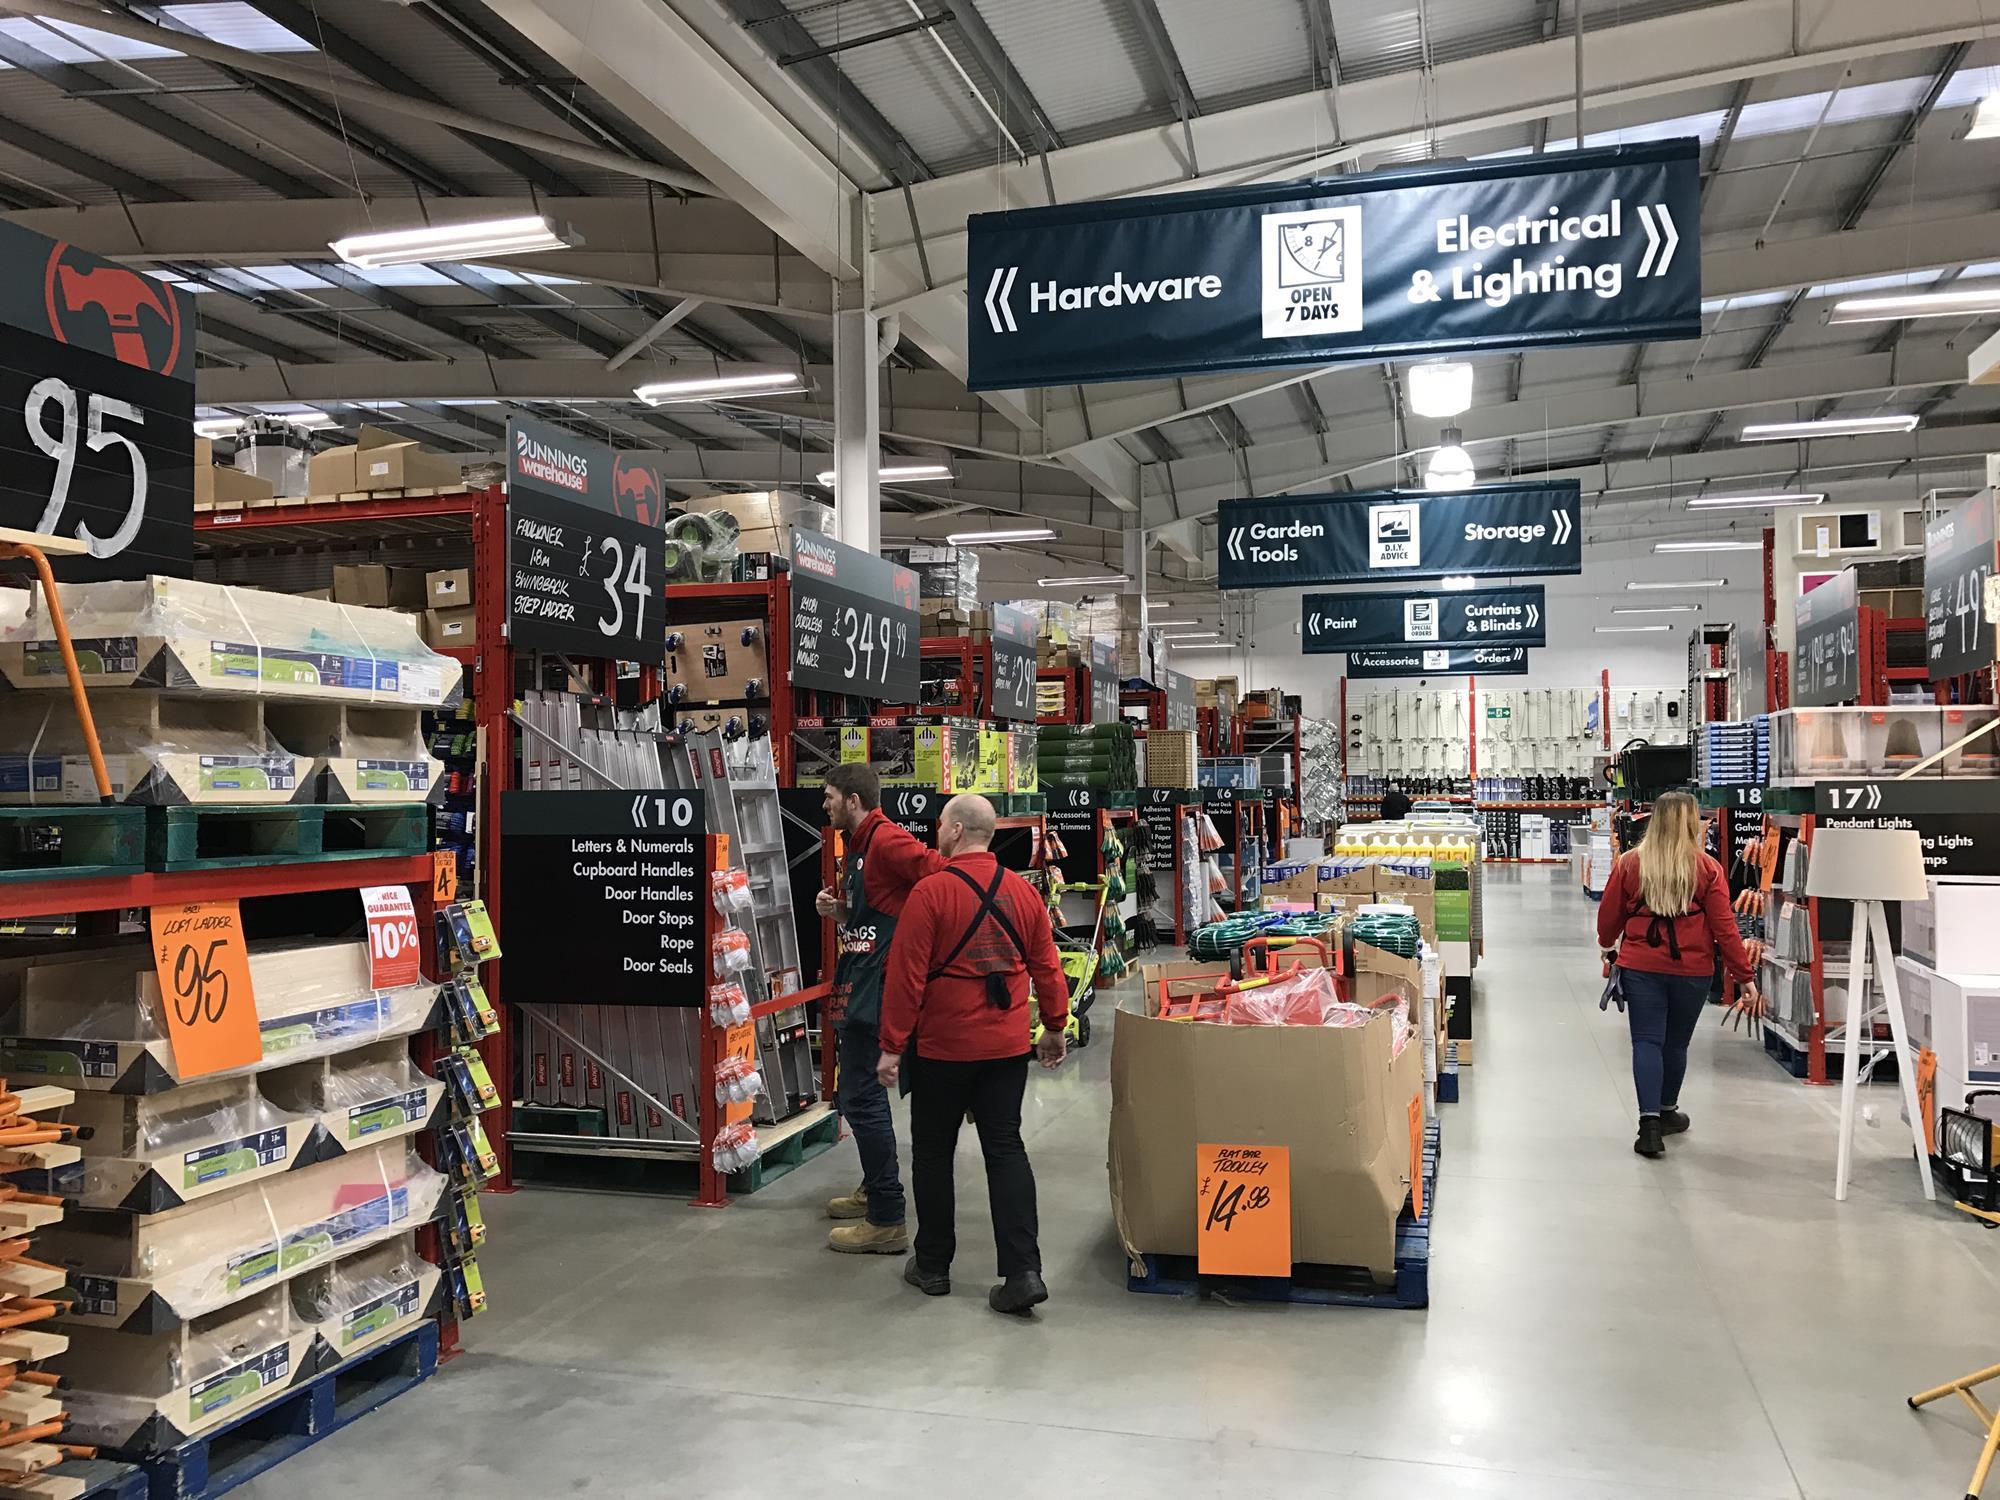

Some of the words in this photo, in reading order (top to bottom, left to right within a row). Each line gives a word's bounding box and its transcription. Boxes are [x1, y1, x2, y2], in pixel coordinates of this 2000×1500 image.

[1437, 199, 1621, 253] Electrical
[1407, 268, 1441, 303] &
[1451, 256, 1622, 307] Lighting
[1030, 272, 1223, 312] Hardware
[1290, 287, 1332, 304] OPEN
[1285, 306, 1296, 322] 7
[1300, 303, 1339, 321] DAYS
[517, 430, 588, 476] BUNNINGS
[24, 378, 148, 558] 95
[523, 459, 583, 490] warehouse
[515, 518, 564, 548] FAULKNER
[1250, 520, 1324, 540] Garden
[1464, 523, 1546, 543] Storage
[795, 532, 836, 565] BUNNINGS
[1250, 546, 1298, 563] Tools
[1380, 551, 1409, 561] ADVICE
[799, 554, 834, 576] warehouse
[515, 570, 570, 598] SWINGBACK
[598, 536, 652, 641] 34
[514, 595, 540, 616] STEP
[540, 599, 575, 621] LADDER
[1465, 603, 1522, 617] Curtains
[1324, 617, 1358, 630] Paint
[1466, 620, 1478, 632] &
[1480, 618, 1522, 632] Blinds
[843, 607, 891, 685] 349
[1363, 656, 1420, 667] Accessories
[1474, 652, 1511, 664] Orders
[797, 718, 823, 727] RYOBI
[870, 718, 896, 727] RYOBI
[942, 731, 951, 790] RYOBI
[1079, 790, 1090, 806] 8
[1161, 790, 1170, 802] 7
[1223, 789, 1232, 798] 6
[1266, 788, 1273, 797] 5
[1737, 788, 1762, 804] 18
[1828, 788, 1864, 809] 17
[654, 797, 693, 827] 10
[911, 794, 927, 814] 9
[1052, 811, 1091, 819] Accessories
[1734, 810, 1762, 820] Heavy
[1826, 817, 1875, 828] Pendant
[1878, 817, 1913, 830] Lights
[897, 821, 928, 833] Dollies
[1060, 822, 1091, 831] Trimmers
[572, 838, 613, 854] Letters
[616, 839, 627, 854] &
[630, 838, 694, 854] Numerals
[1938, 835, 1974, 849] Lights
[1923, 856, 1948, 867] mps
[573, 861, 638, 880] Cupboard
[641, 861, 694, 878] Handles
[604, 886, 637, 902] Door
[640, 885, 694, 902] Handles
[367, 902, 412, 913] GUARANTEE
[162, 918, 193, 936] LOFT
[193, 916, 233, 931] LADDER
[622, 910, 654, 926] Door
[658, 910, 694, 928] Stops
[370, 921, 417, 959] 10%
[660, 935, 694, 953] Rope
[623, 958, 655, 974] Door
[658, 957, 694, 974] Seals
[174, 939, 228, 1026] 95
[1242, 1150, 1262, 1159] BAR
[1213, 1158, 1269, 1176] TROLLEY
